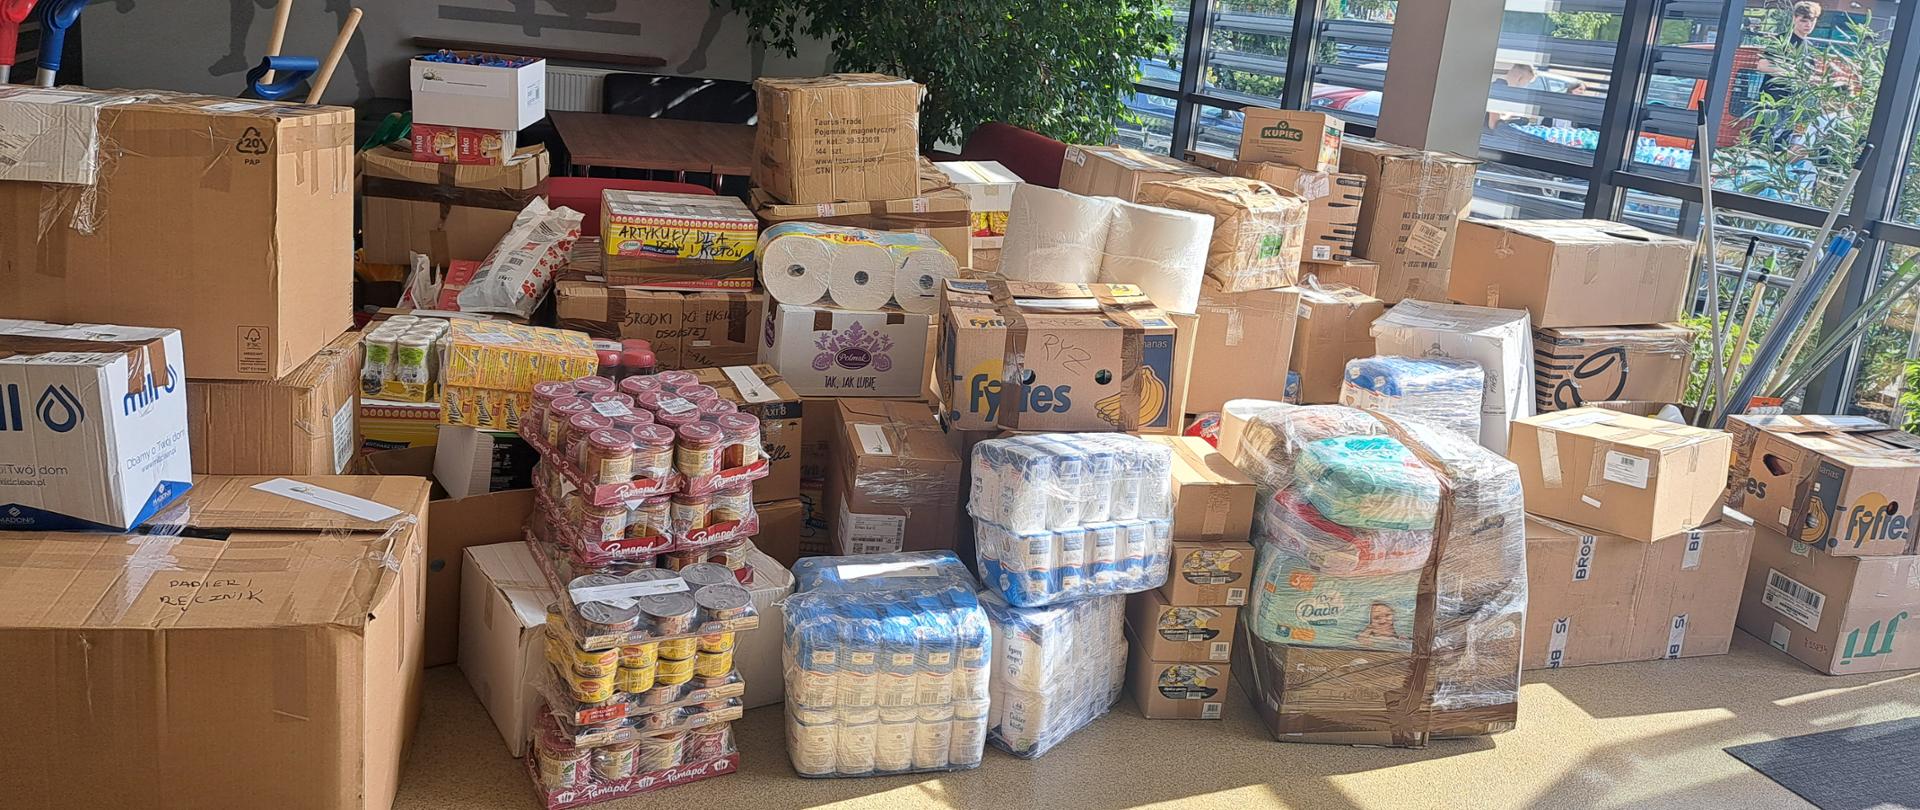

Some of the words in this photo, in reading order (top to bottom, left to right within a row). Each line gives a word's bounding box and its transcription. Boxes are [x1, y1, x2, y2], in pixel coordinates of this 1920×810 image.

[814, 128, 846, 137] Pojemnik
[850, 127, 896, 135] magnetyczny
[1264, 129, 1301, 140] KUPIEC
[244, 138, 260, 148] 20
[696, 230, 728, 244] DLA
[624, 310, 672, 327] ŚRODKI
[1144, 339, 1168, 348] nanas
[825, 376, 839, 389] TAK,
[841, 376, 855, 388] JAK
[857, 376, 877, 391] LUBIĘ
[970, 374, 1071, 422] fyfes
[39, 465, 68, 475] dom
[711, 471, 753, 489] Pamapol
[615, 484, 661, 500] Pamapol
[692, 528, 738, 544] Pamapol
[605, 542, 655, 559] Pamapol
[1575, 535, 1594, 580] BROS
[1300, 604, 1339, 617] Dada
[665, 764, 708, 782] Pamapol
[585, 780, 632, 799] Pamapol
